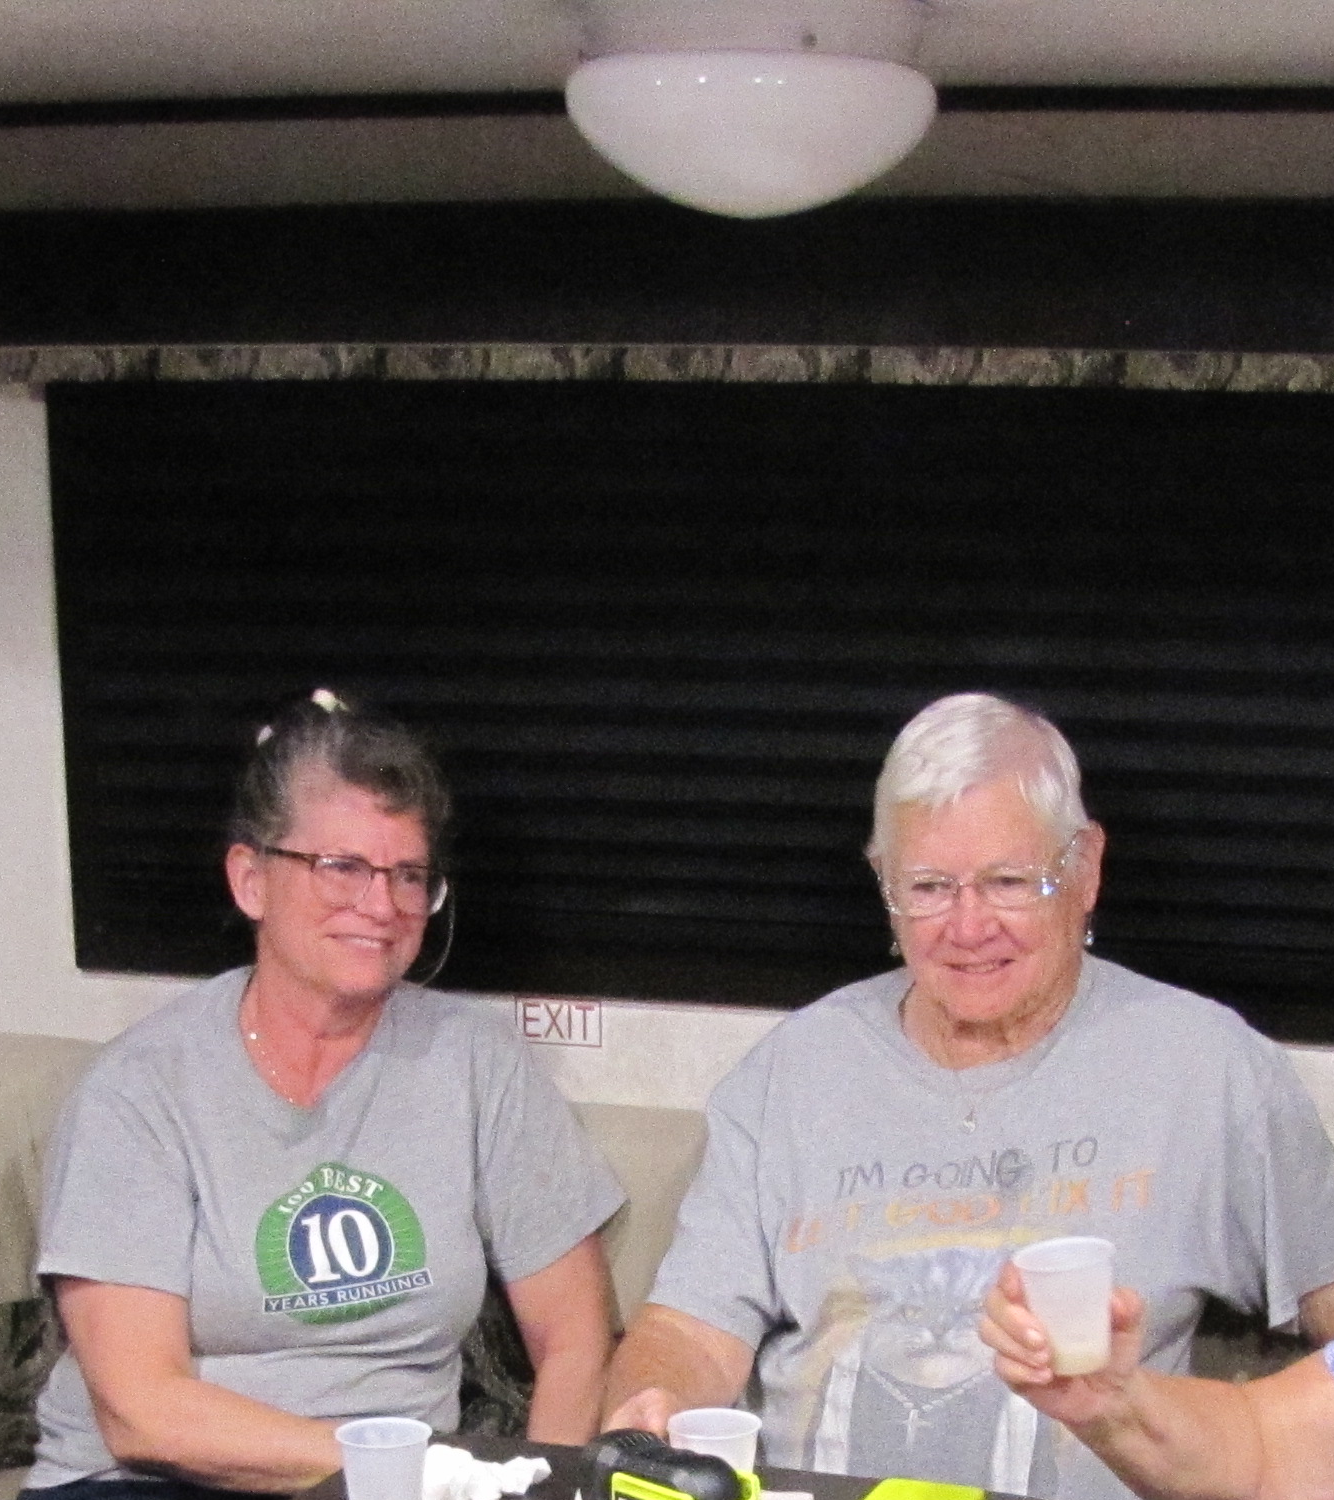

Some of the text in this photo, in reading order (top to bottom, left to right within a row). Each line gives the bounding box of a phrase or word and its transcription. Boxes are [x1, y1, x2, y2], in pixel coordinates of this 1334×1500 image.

[523, 1001, 595, 1041] EXIT
[320, 1166, 384, 1200] BEST
[902, 1147, 1033, 1192] GOING
[1050, 1136, 1099, 1173] TO
[301, 1209, 379, 1284] 10
[269, 1273, 427, 1312] YEARS RUNNING
